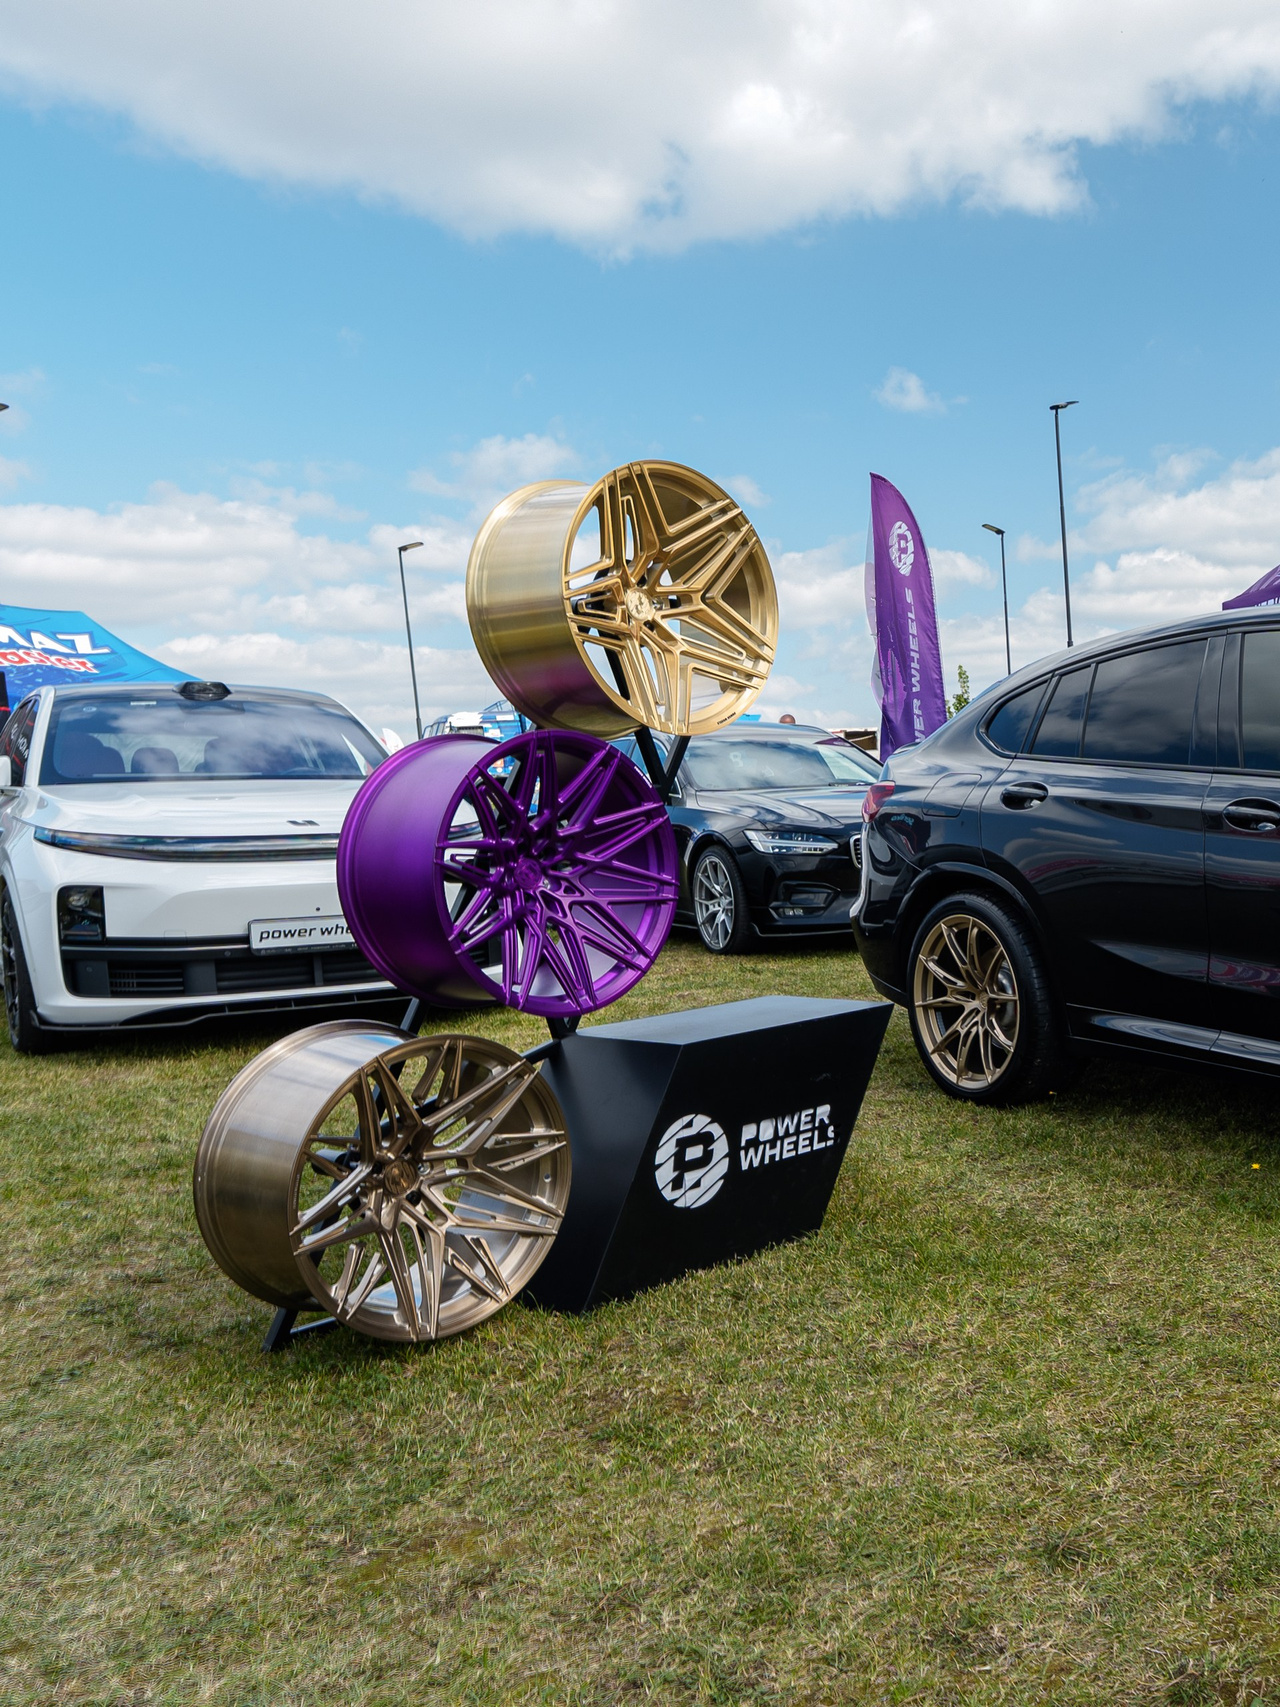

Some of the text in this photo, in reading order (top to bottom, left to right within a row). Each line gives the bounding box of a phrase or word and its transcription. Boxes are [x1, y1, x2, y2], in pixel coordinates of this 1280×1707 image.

[904, 586, 922, 694] WHEELS
[259, 926, 317, 943] power
[740, 1103, 831, 1147] POWER
[740, 1125, 836, 1171] WHEELS
